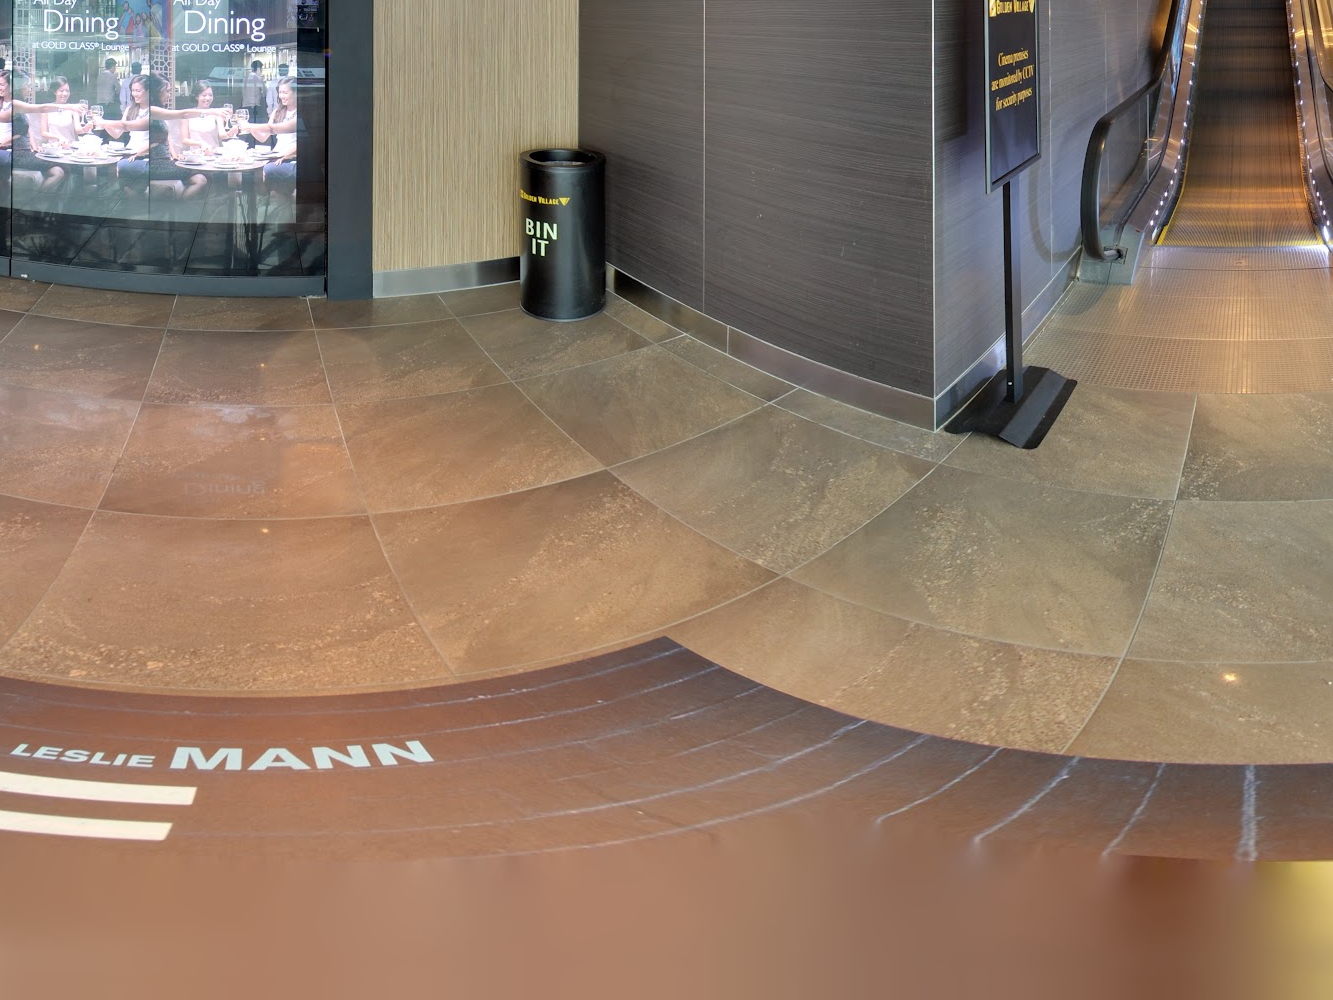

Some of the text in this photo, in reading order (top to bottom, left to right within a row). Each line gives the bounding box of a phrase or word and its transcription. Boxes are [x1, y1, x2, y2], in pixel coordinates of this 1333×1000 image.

[997, 0, 1012, 14] GOLDEN
[43, 9, 119, 40] Dining
[184, 10, 266, 42] Dining
[40, 41, 67, 49] GOLD
[101, 42, 129, 53] Lounge
[181, 43, 210, 52] GOLD
[246, 43, 276, 54] Lounge
[998, 47, 1029, 67] Cinema premises
[991, 80, 999, 91] are
[999, 69, 1018, 89] monitored
[1023, 64, 1034, 80] CCTV
[1002, 90, 1017, 107] security
[1017, 87, 1033, 105] purposes
[538, 196, 559, 206] VILLAGE
[526, 218, 557, 240] BIN
[532, 238, 549, 257] IT
[9, 743, 157, 768] LESLIE
[169, 740, 435, 771] MANN
